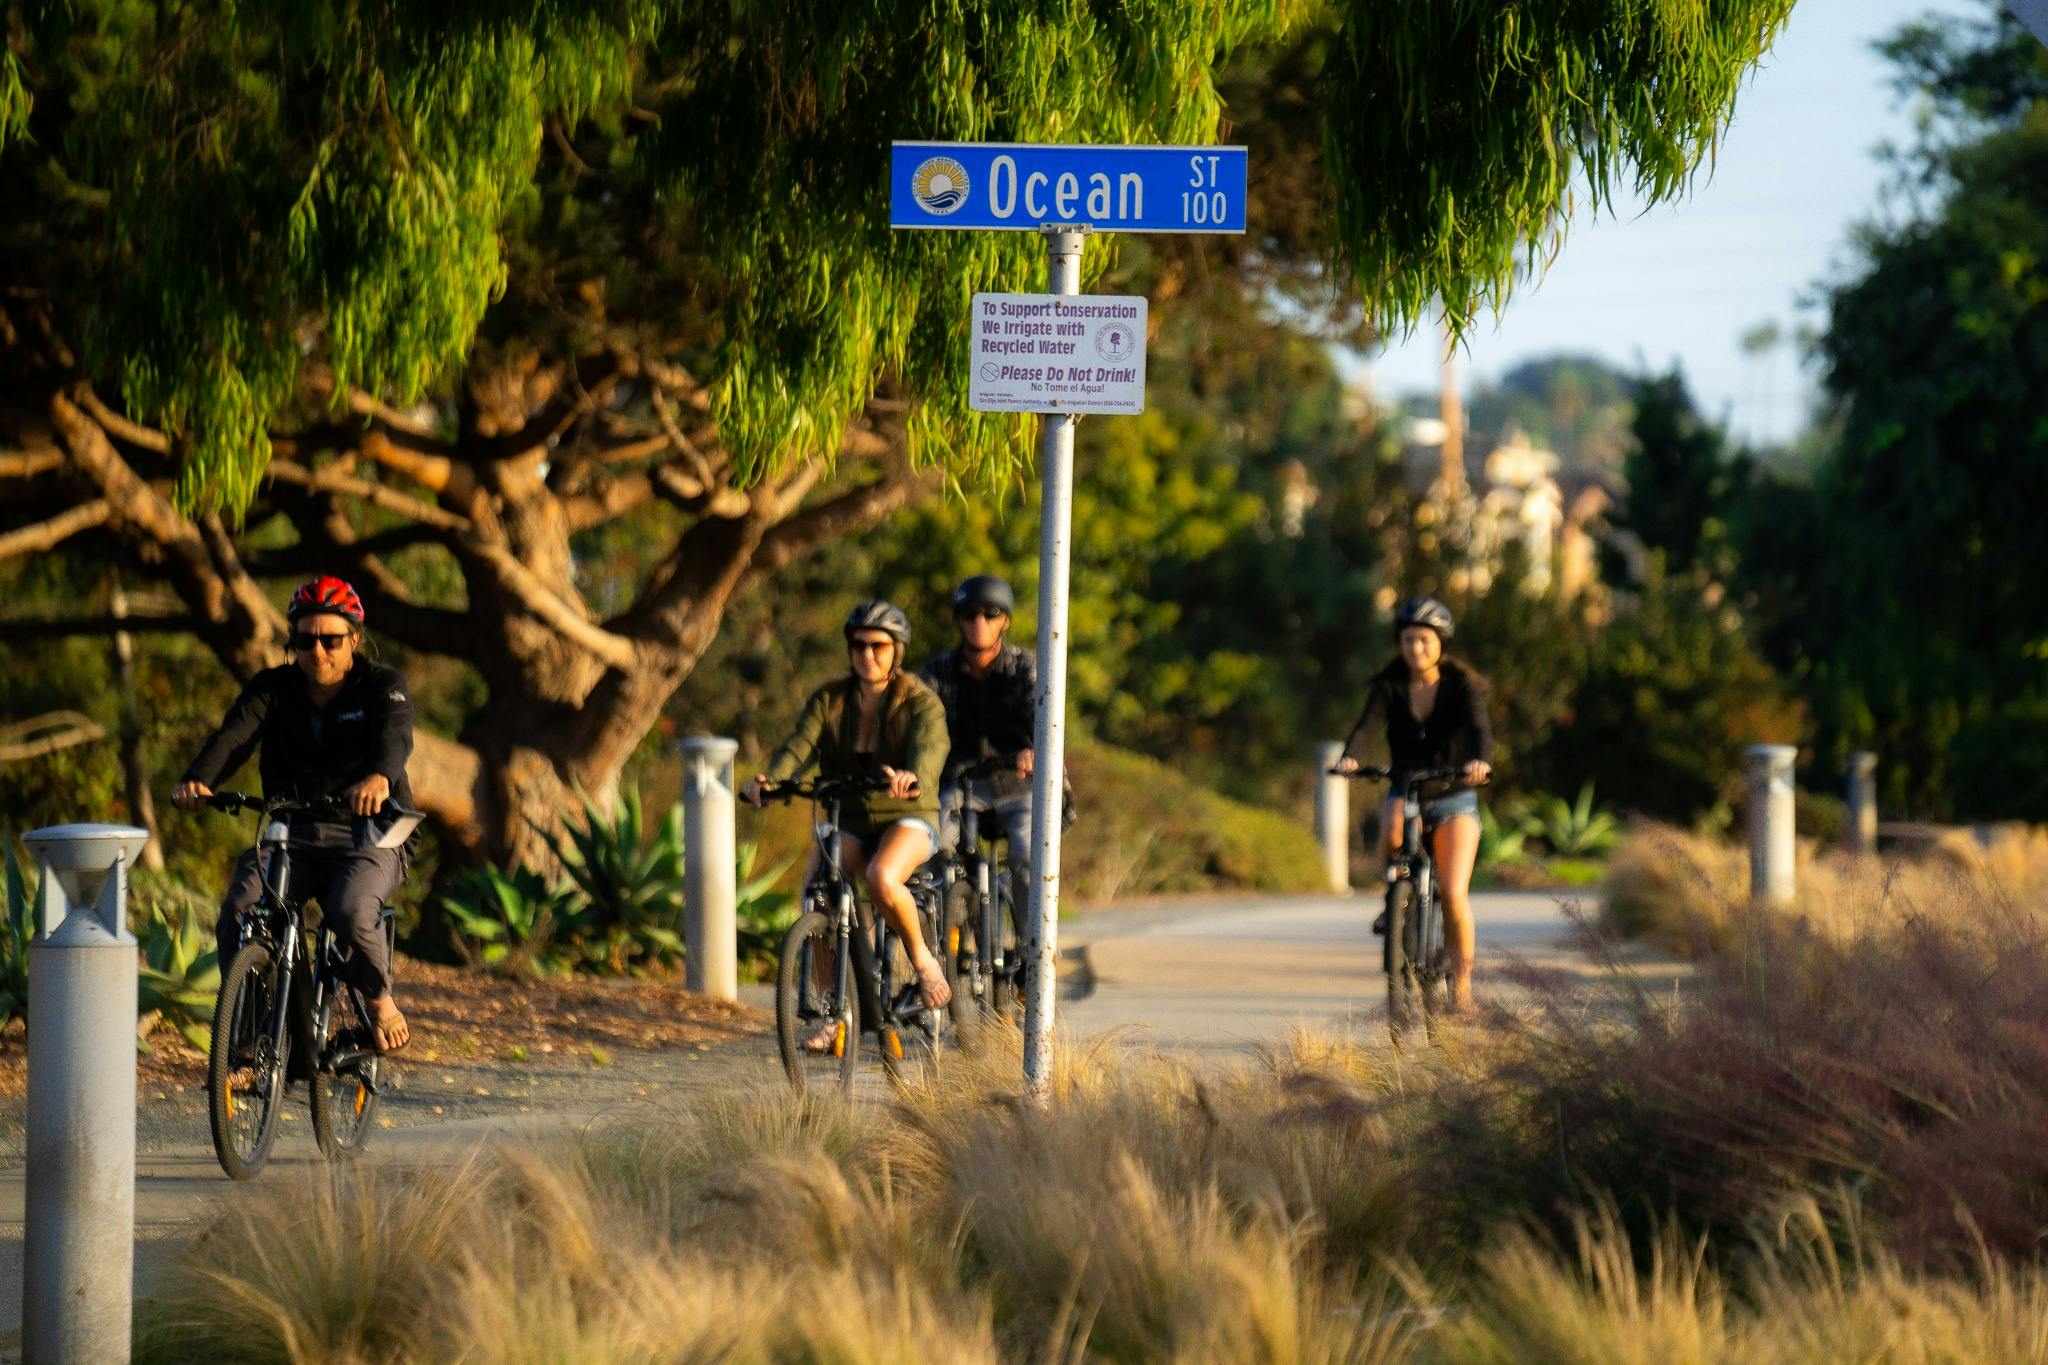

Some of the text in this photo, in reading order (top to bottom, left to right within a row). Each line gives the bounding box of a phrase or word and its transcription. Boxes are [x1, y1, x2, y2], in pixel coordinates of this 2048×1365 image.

[989, 155, 1144, 220] Ocean
[1190, 155, 1221, 188] ST
[1182, 191, 1228, 225] 100
[983, 302, 1137, 319] To Support Conservation
[982, 320, 1085, 337] We Irrigate with
[981, 339, 1076, 356] Recycled Water
[1001, 365, 1137, 383] Please Do Not Drink!
[1031, 382, 1105, 395] No Tome el Agua!
